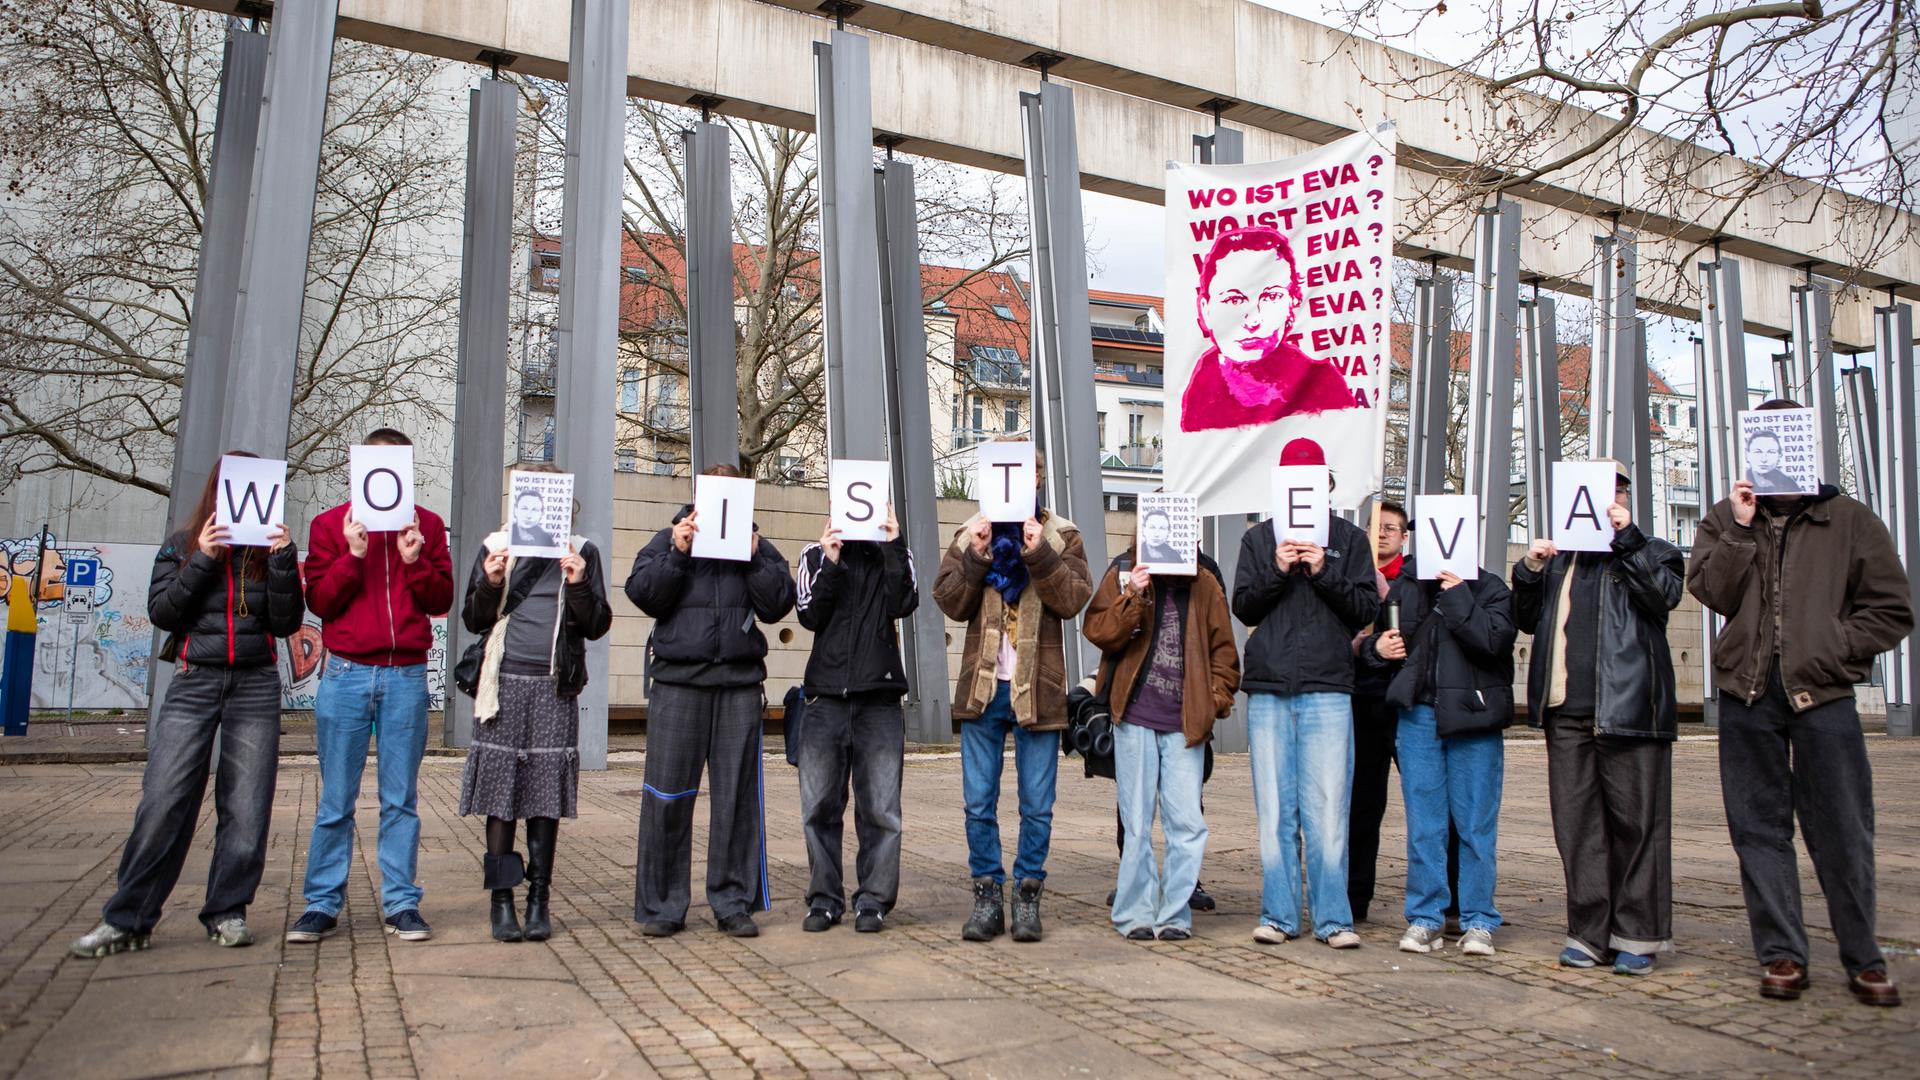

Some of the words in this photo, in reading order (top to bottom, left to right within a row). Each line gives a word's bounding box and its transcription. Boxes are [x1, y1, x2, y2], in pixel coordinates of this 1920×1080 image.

[1188, 188, 1237, 209] WO
[1246, 179, 1294, 204] IST
[1303, 163, 1359, 193] EVA
[1367, 155, 1383, 176] ?
[1190, 216, 1239, 242] WO
[1247, 208, 1297, 230] IST
[1306, 196, 1359, 224] EVA
[1367, 190, 1383, 209] ?
[1307, 227, 1360, 257] EVA
[1368, 223, 1382, 243] ?
[1307, 260, 1362, 288] EVA
[1370, 256, 1381, 277] ?
[1309, 291, 1366, 318] EVA
[1372, 288, 1383, 310] ?
[1312, 324, 1366, 351] EVA
[1372, 323, 1381, 343] ?
[1334, 356, 1367, 376] VA
[225, 479, 280, 525] W
[364, 468, 402, 511] O
[846, 482, 873, 521] S
[993, 463, 1022, 502] T
[1289, 488, 1314, 528] E
[1565, 486, 1601, 530] A
[1429, 518, 1464, 559] V
[73, 562, 90, 583] P
